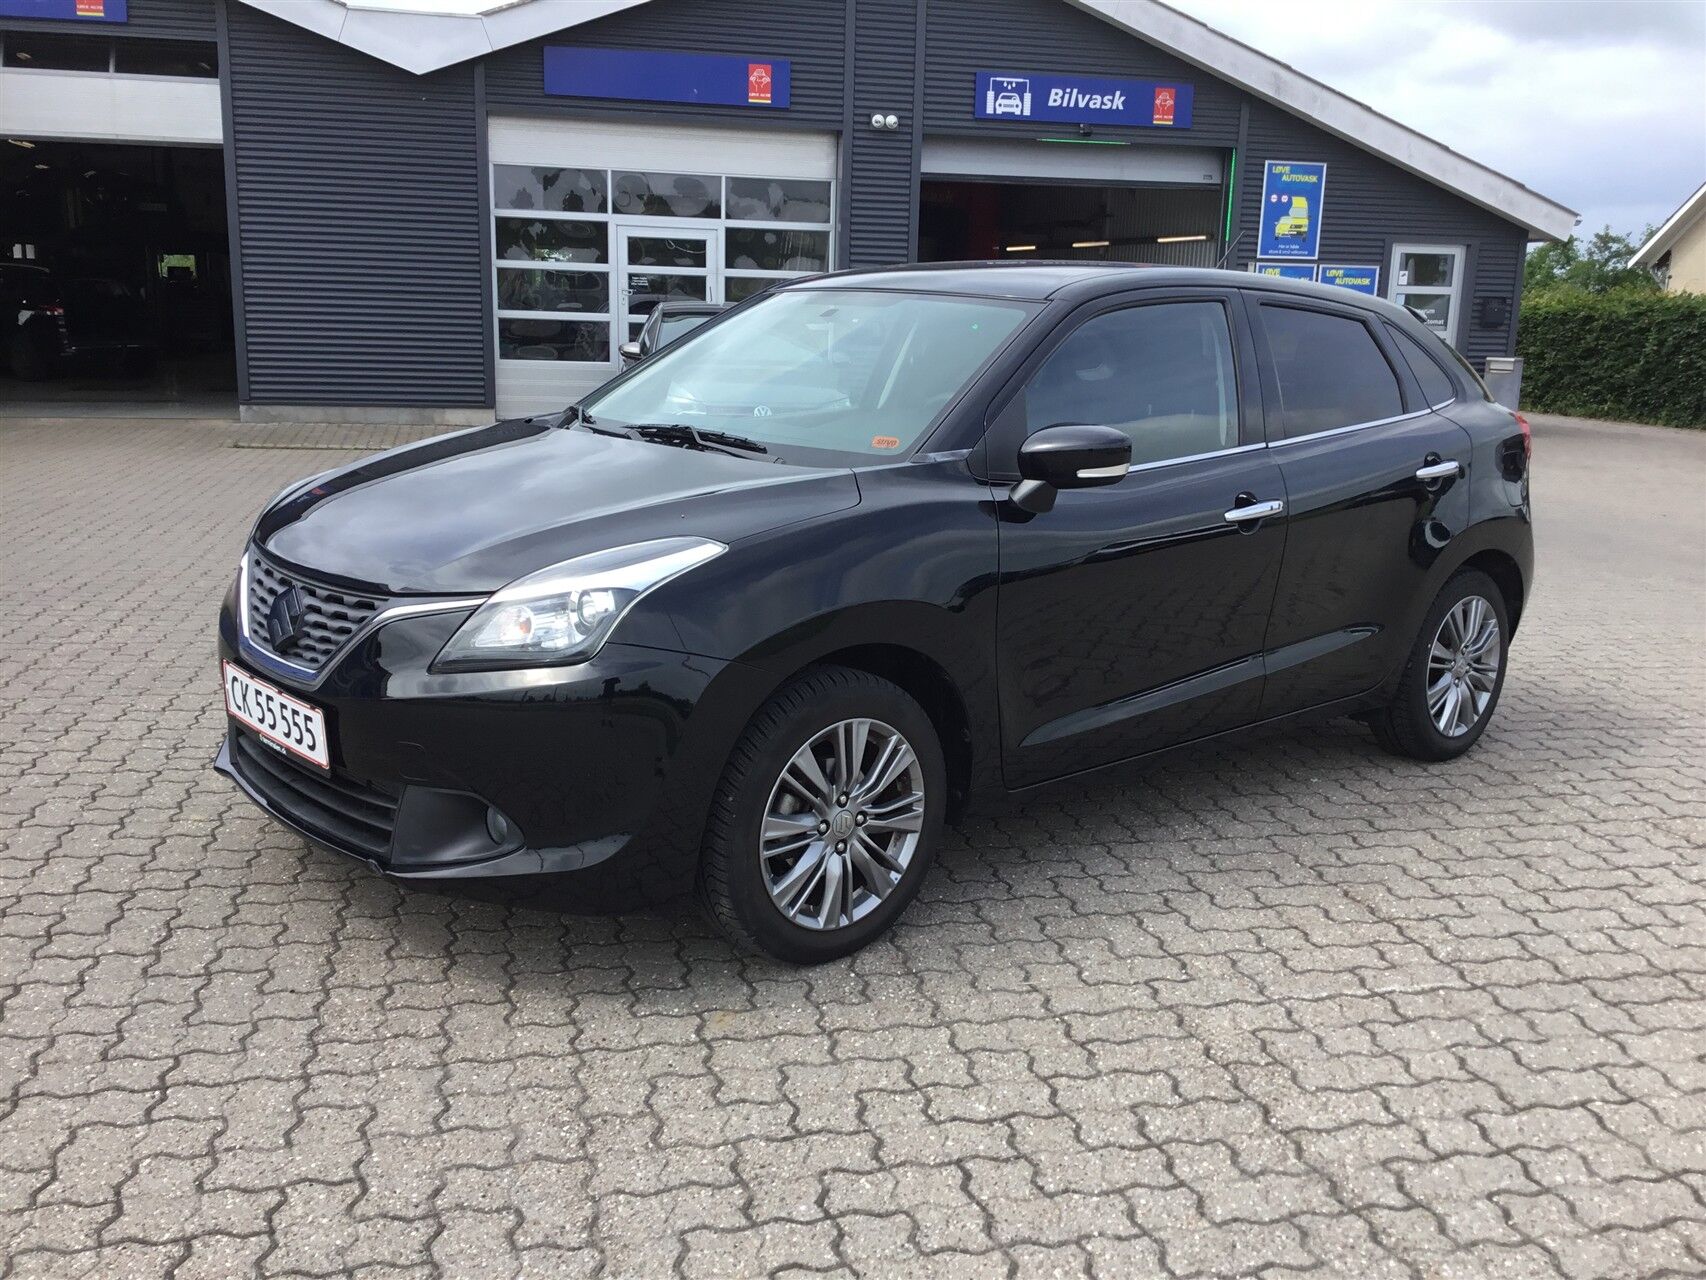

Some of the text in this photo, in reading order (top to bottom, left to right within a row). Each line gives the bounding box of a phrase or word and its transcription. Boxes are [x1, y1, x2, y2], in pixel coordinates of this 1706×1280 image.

[1047, 88, 1126, 110] Bilvask
[1272, 165, 1291, 174] LØVE
[1281, 174, 1319, 183] AUTOVASK
[1335, 277, 1371, 286] AUTOVASK
[231, 675, 253, 718] CK
[254, 688, 277, 731] 55
[279, 701, 316, 752] 555
